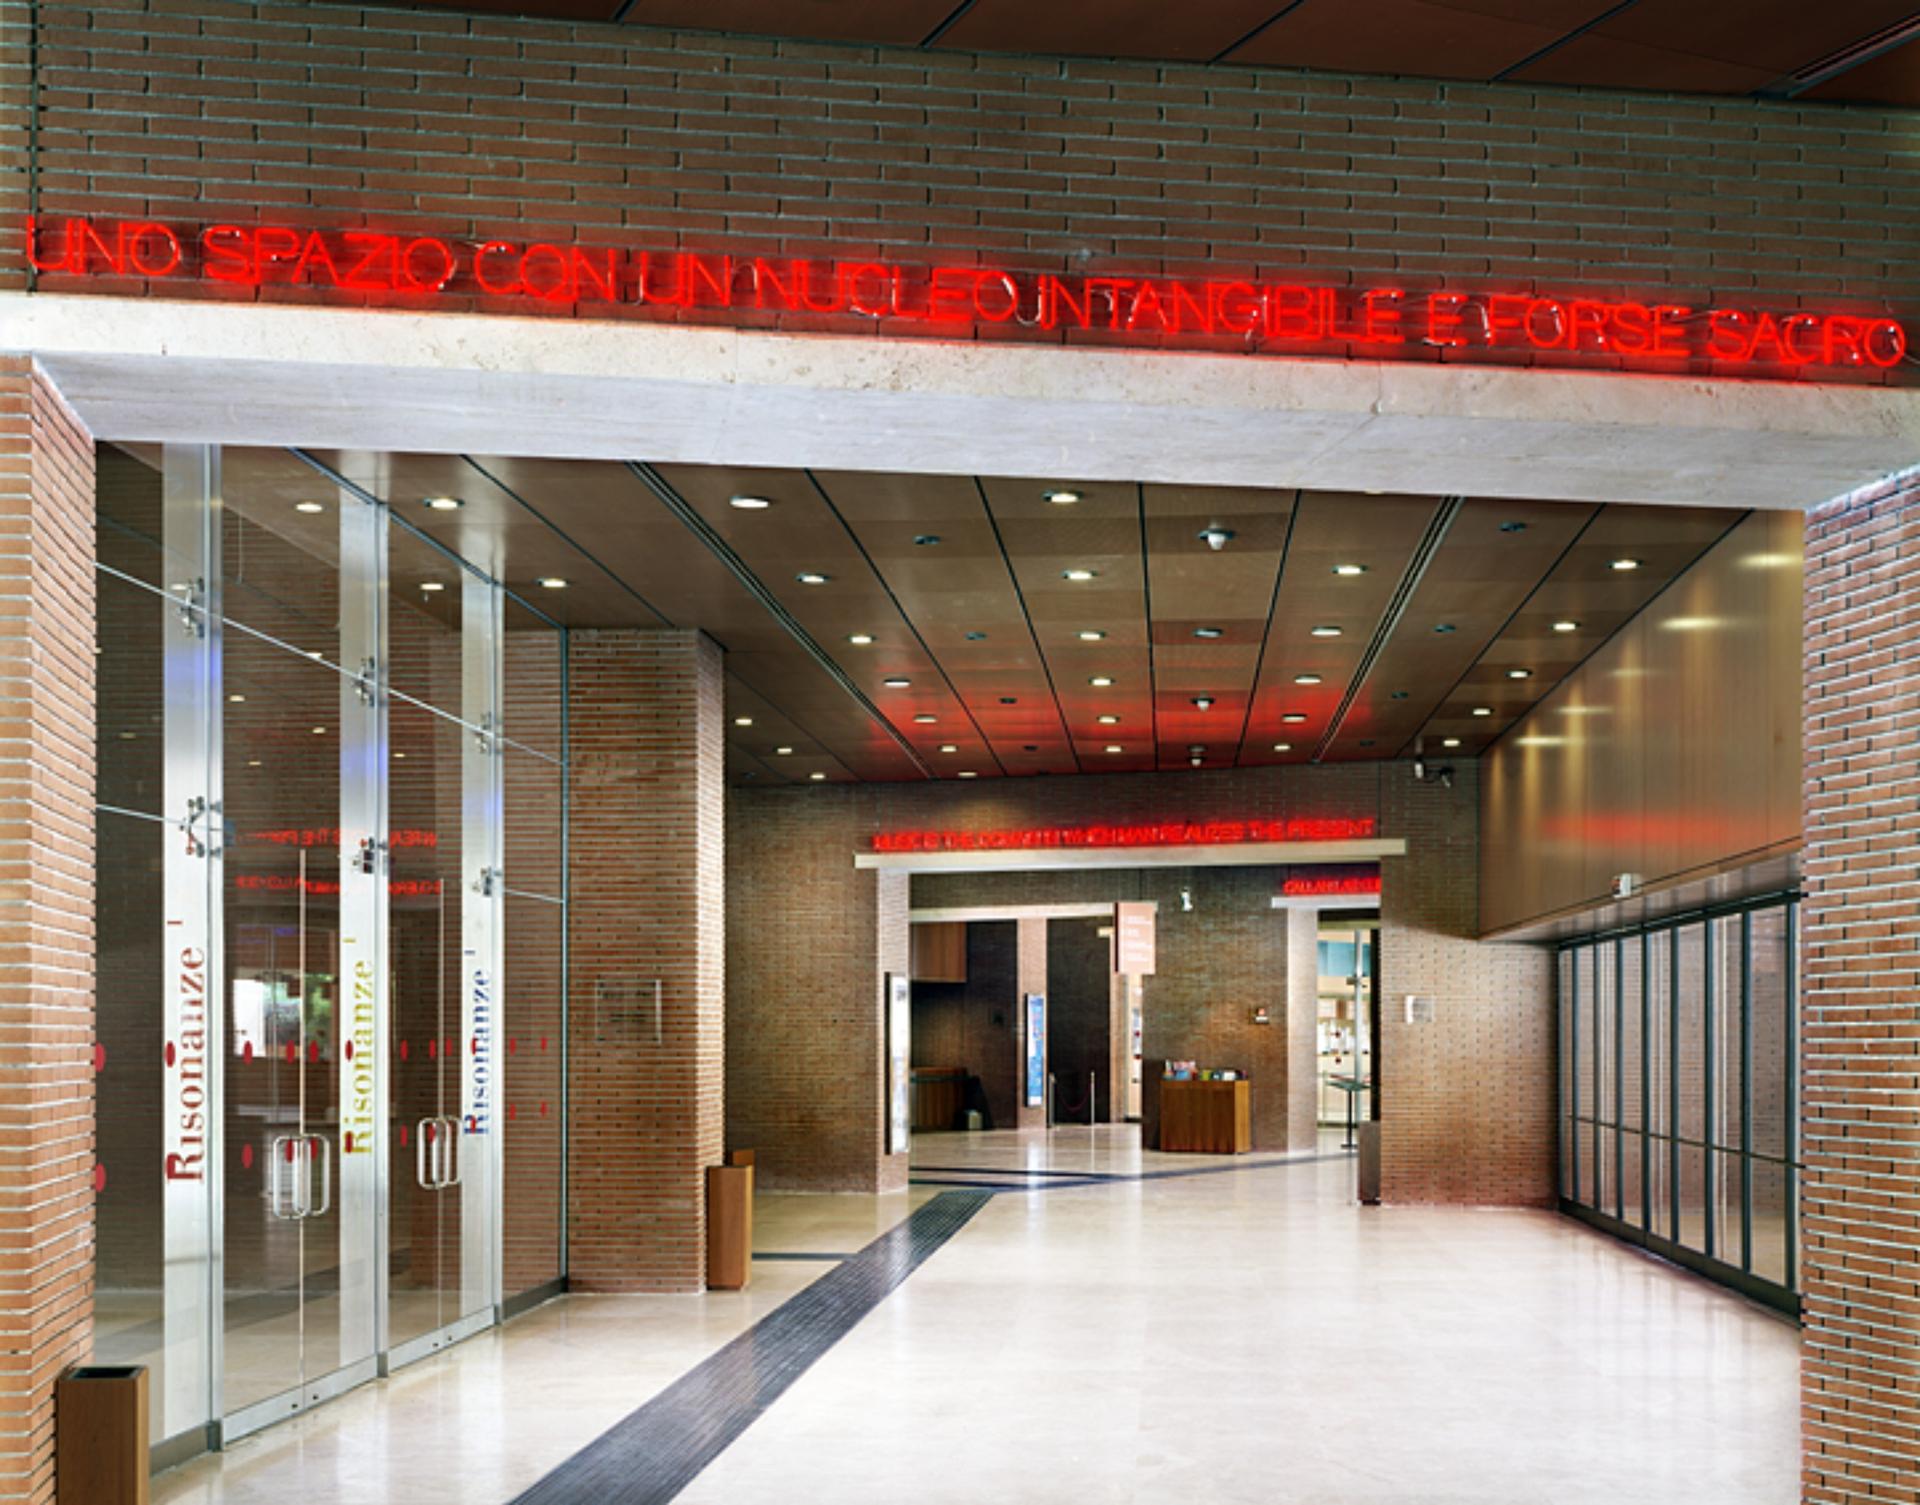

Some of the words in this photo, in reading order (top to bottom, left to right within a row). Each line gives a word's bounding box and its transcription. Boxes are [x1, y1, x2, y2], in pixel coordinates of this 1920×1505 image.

[26, 215, 180, 277] UNO
[203, 225, 455, 290] SPAZIO
[475, 241, 615, 302] CON
[640, 253, 731, 306] UN
[756, 257, 1017, 322] NUCLEO
[1042, 275, 1404, 343] INTANGIBILE
[1428, 294, 1467, 345] E
[1488, 295, 1690, 357] FORSE
[1708, 310, 1905, 367] SACRO
[1248, 819, 1284, 840] THE
[1287, 817, 1374, 838] PRESENT
[166, 947, 205, 1182] Risonanze
[343, 961, 373, 1154] Risonanze
[463, 970, 490, 1135] Risonanze
